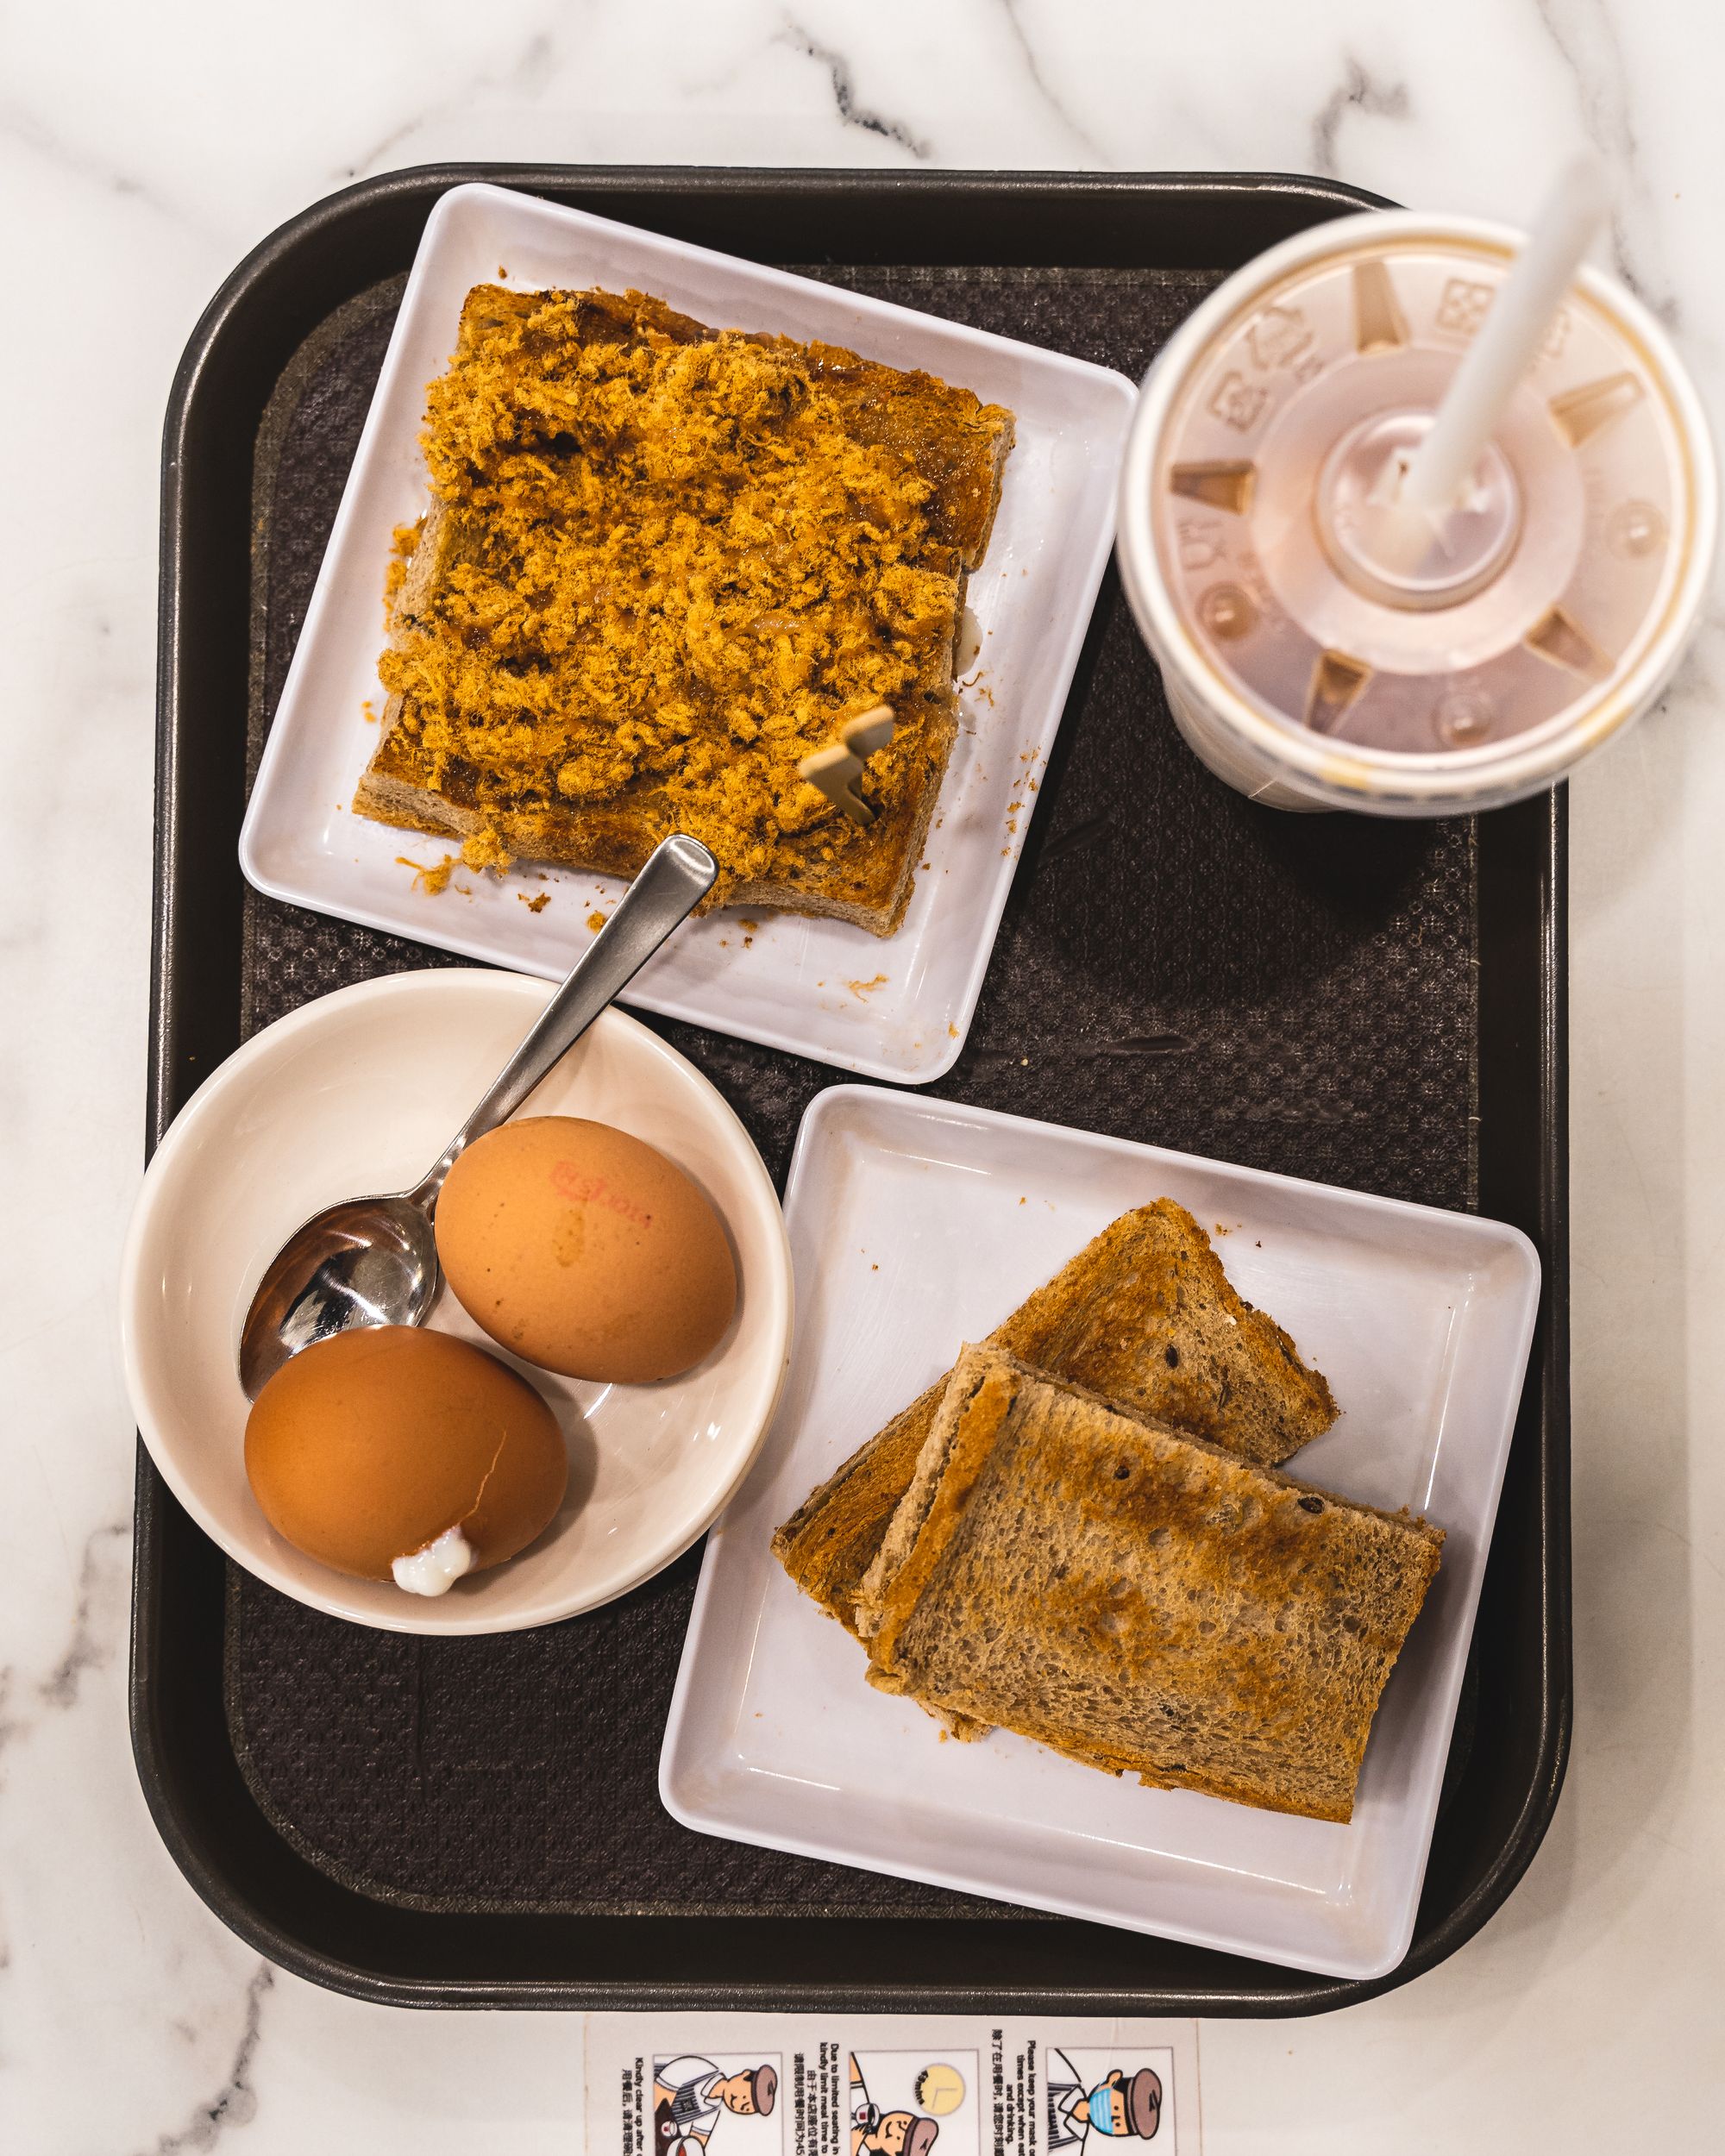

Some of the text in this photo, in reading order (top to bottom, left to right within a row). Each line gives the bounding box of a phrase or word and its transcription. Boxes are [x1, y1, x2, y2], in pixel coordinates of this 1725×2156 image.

[819, 2042, 828, 2070] kindly
[831, 2043, 839, 2061] Due
[1027, 2040, 1036, 2071] Please
[634, 2057, 643, 2087] Kindly
[831, 2065, 838, 2073] to
[820, 2072, 829, 2094] limit
[1026, 2073, 1036, 2096] keep
[820, 2096, 829, 2119] meal
[1016, 2083, 1026, 2112] except
[1027, 2097, 1036, 2118] your
[634, 2115, 643, 2127] up
[831, 2110, 839, 2144] seating
[1005, 2103, 1015, 2145] drinking.
[636, 2129, 644, 2151] after
[1028, 2121, 1038, 2146] mask
[821, 2145, 829, 2153] to
